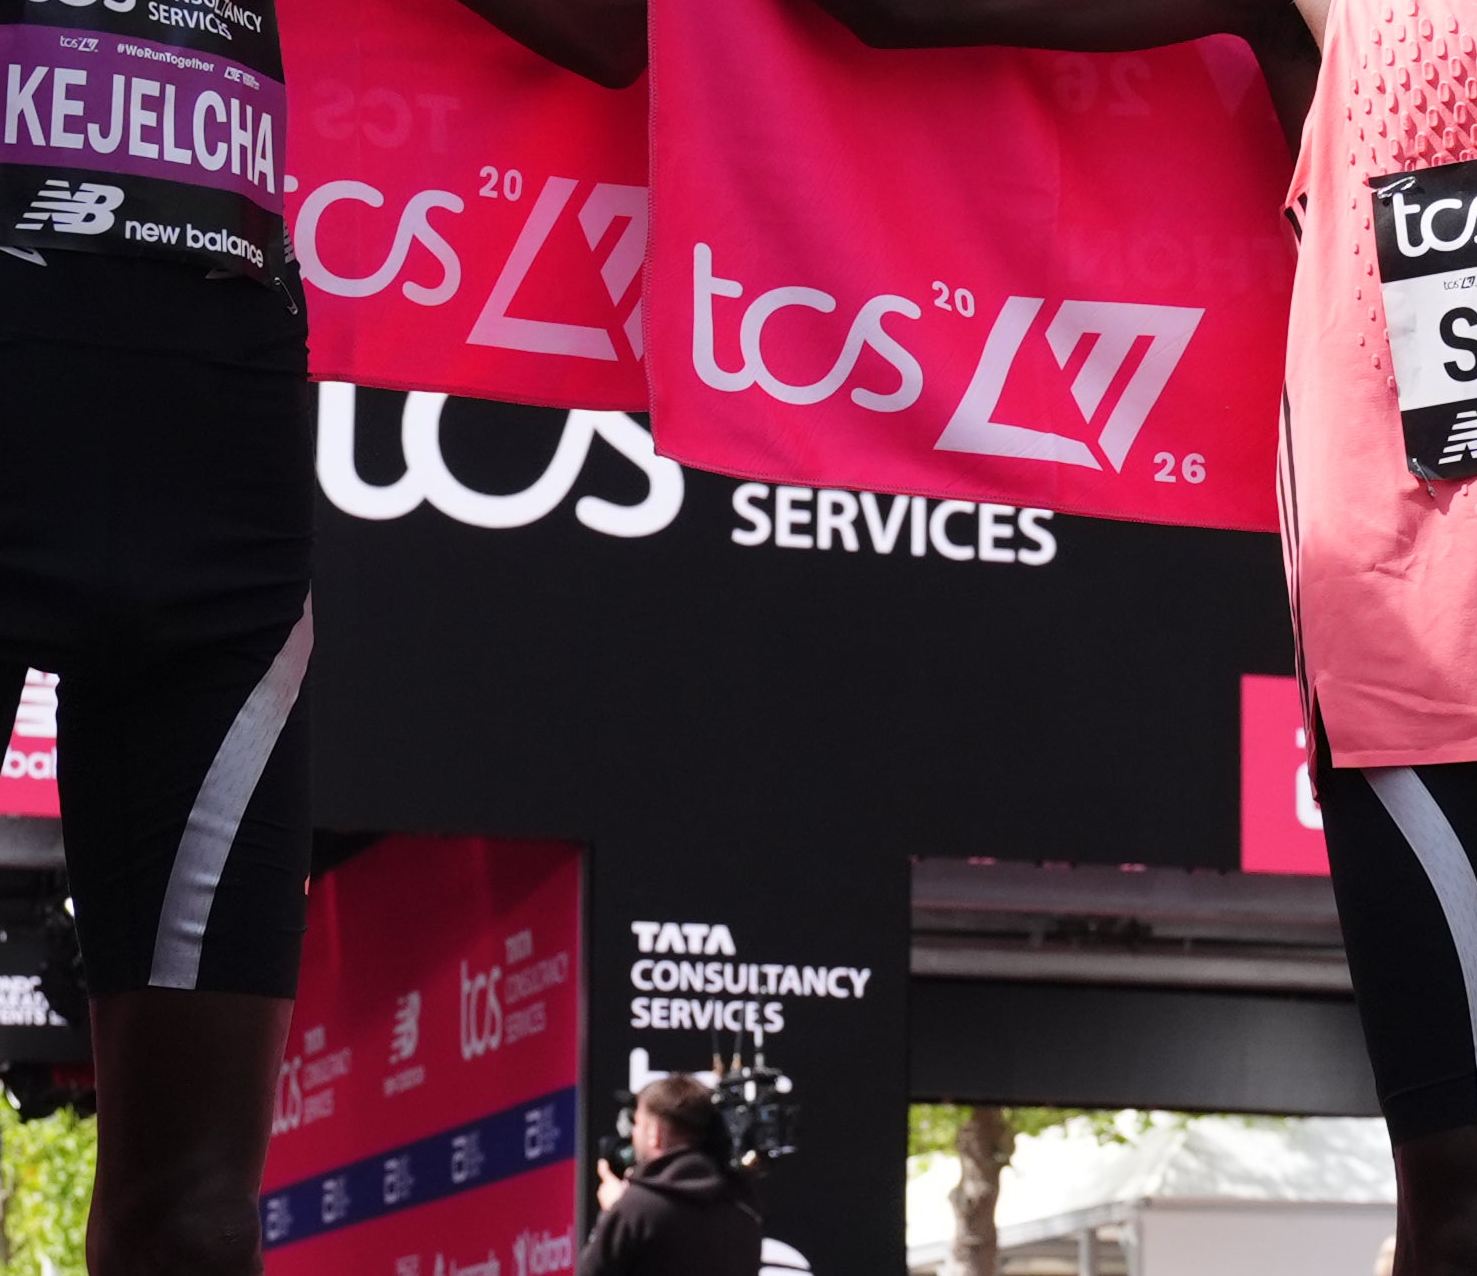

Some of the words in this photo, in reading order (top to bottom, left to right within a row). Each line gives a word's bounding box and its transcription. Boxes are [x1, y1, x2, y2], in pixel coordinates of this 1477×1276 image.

[116, 42, 216, 74] #WeRunTogether
[3, 63, 277, 195] KEJELCHA
[124, 219, 182, 244] new
[185, 223, 264, 269] balance
[286, 174, 466, 308] cs
[479, 165, 523, 202] 20
[692, 242, 924, 413] tcs
[932, 279, 976, 320] 20
[1153, 451, 1206, 486] 26
[731, 481, 1058, 566] SERVICES
[631, 921, 737, 956] TATA
[630, 958, 872, 999] CONSULTANCY
[459, 959, 503, 1061] tcs
[630, 996, 785, 1033] SERVICES
